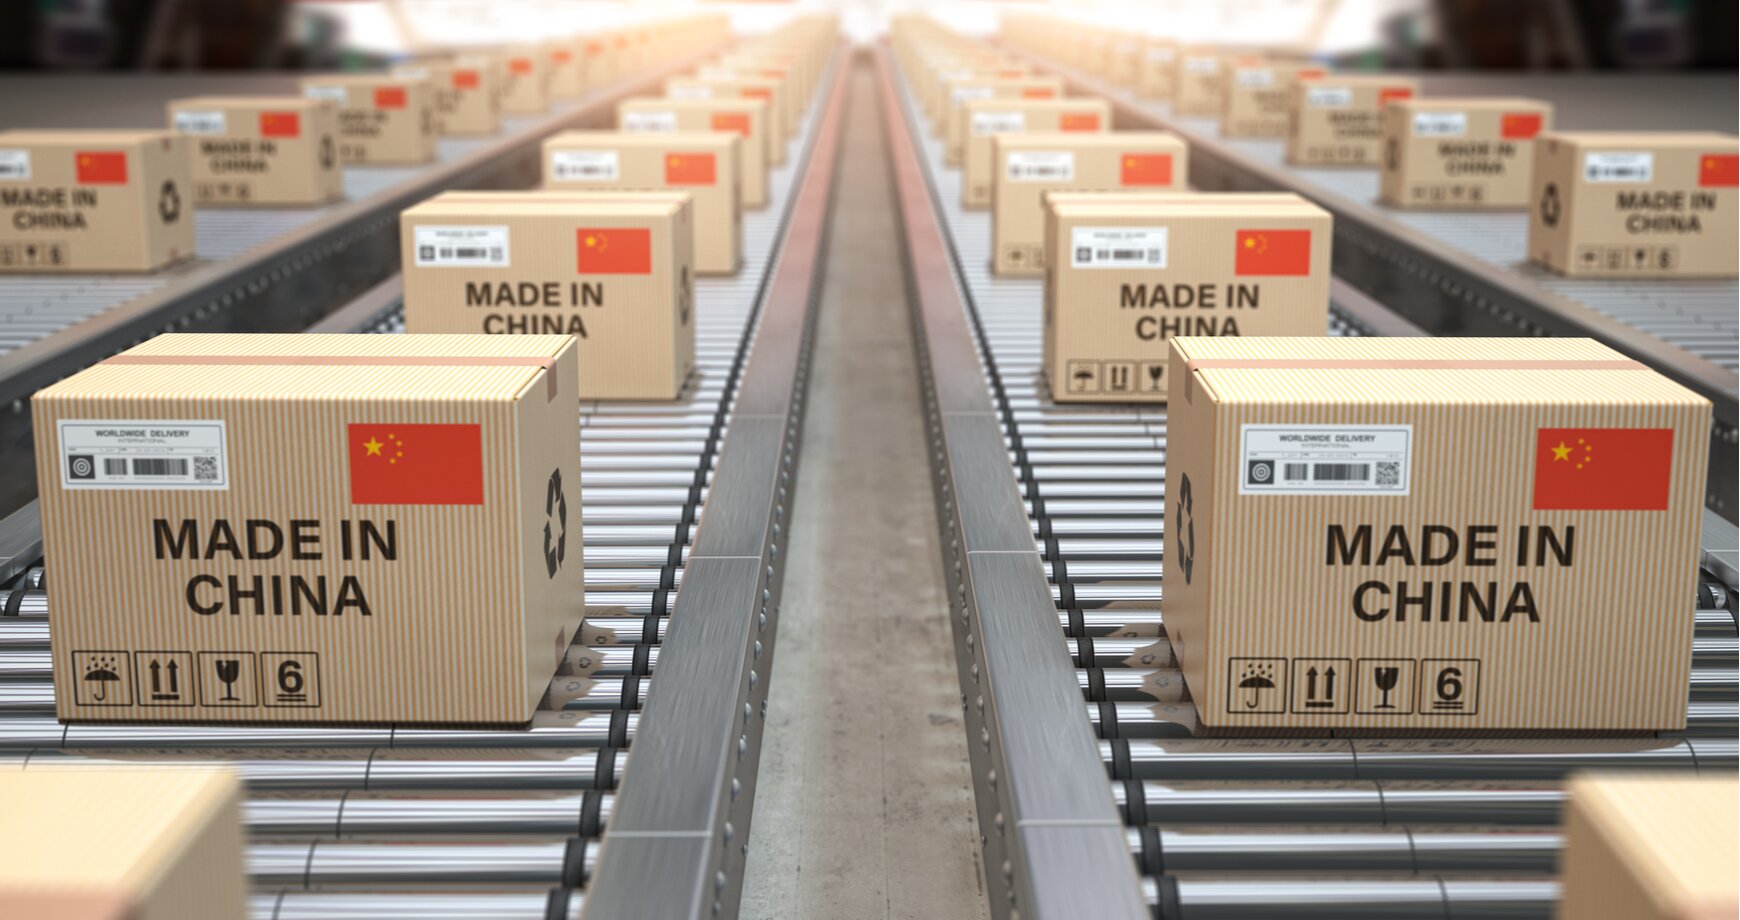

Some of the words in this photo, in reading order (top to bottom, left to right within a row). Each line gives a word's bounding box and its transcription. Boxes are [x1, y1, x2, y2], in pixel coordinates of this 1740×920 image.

[72, 188, 98, 207] IN
[1616, 191, 1684, 211] MADE
[1690, 191, 1717, 211] IN
[465, 281, 561, 307] MADE
[570, 281, 604, 307] IN
[1120, 283, 1216, 309] MADE
[1226, 283, 1260, 309] IN
[482, 313, 588, 338] CHINA
[1135, 315, 1241, 340] CHINA
[1279, 434, 1331, 442] WORLDWIDE
[1335, 434, 1376, 443] DELIVERY
[152, 518, 323, 561] MADE
[340, 519, 398, 561] IN
[1325, 524, 1498, 567] MADE
[1516, 525, 1575, 567] IN
[185, 573, 373, 617] CHINA
[1351, 579, 1541, 623] CHINA
[276, 660, 304, 694] 6
[1435, 667, 1463, 701] 6
